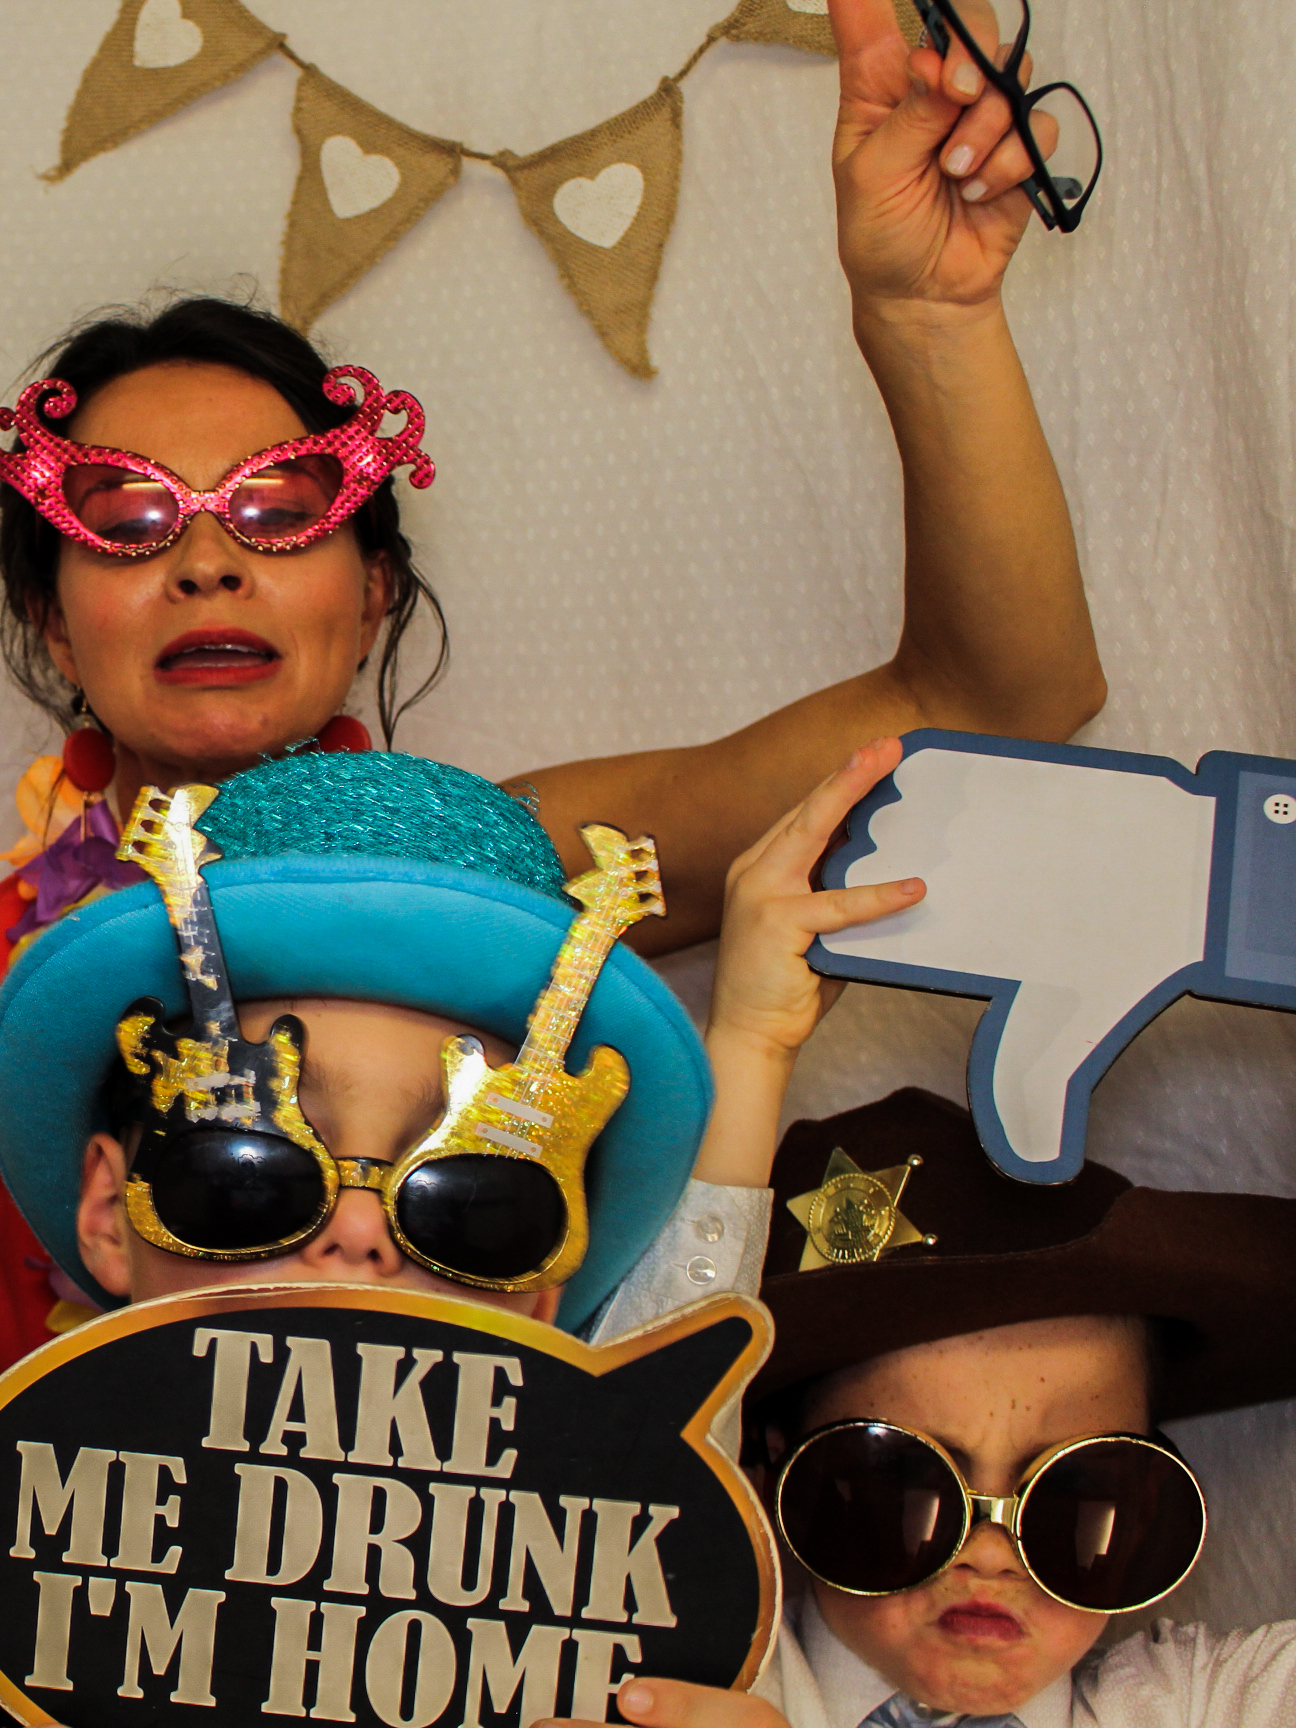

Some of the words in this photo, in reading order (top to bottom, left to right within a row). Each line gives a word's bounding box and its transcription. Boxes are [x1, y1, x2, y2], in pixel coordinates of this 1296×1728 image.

[193, 1327, 524, 1478] TAKE
[9, 1441, 188, 1574] ME
[225, 1462, 680, 1629] DRUNK
[25, 1571, 226, 1707] I'M
[261, 1597, 643, 1728] HOME
